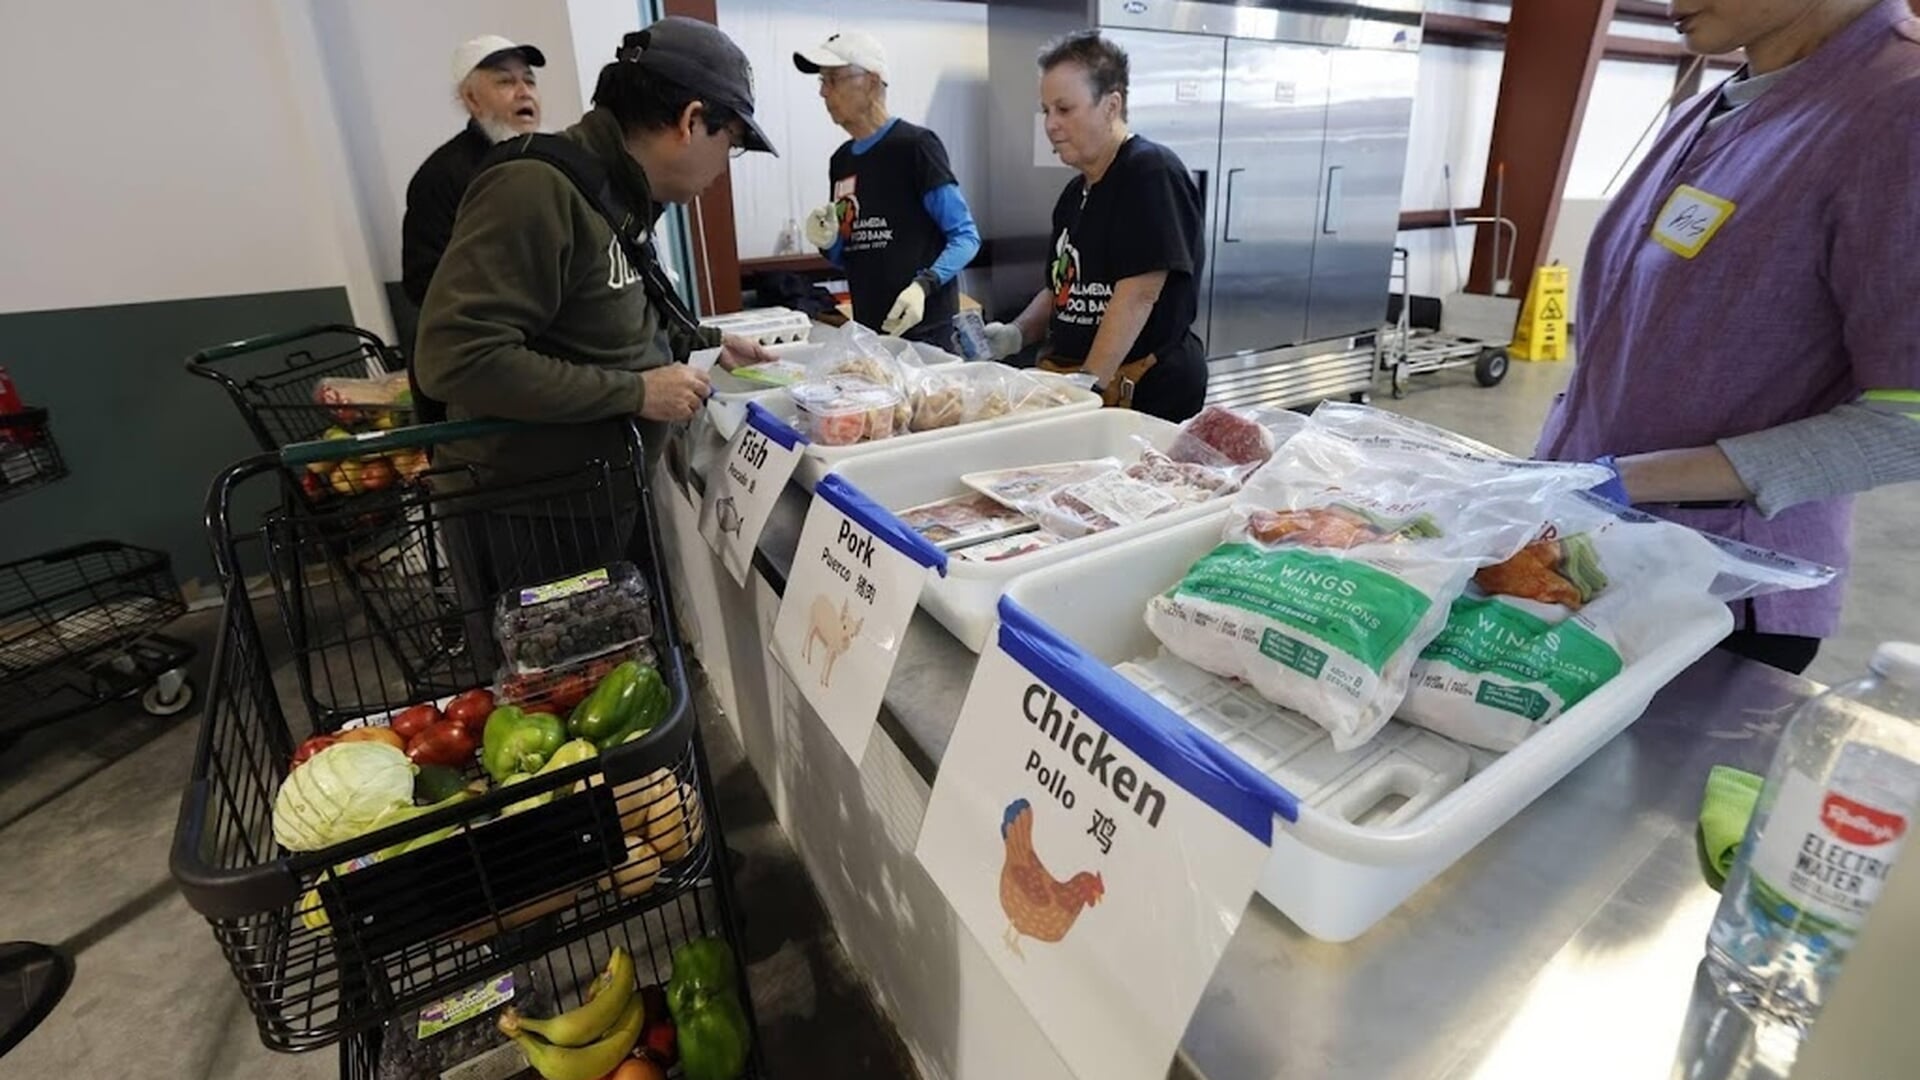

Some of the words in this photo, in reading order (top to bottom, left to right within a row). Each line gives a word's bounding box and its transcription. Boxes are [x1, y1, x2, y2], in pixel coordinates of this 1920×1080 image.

[868, 229, 893, 240] BANK
[738, 429, 769, 469] Fish
[821, 546, 851, 582] Puerco
[837, 518, 876, 568] Pork
[1280, 563, 1357, 598] WINGS
[1280, 579, 1310, 599] WING
[1312, 591, 1382, 630] SECTIONS
[1478, 612, 1562, 652] WINS
[1022, 683, 1167, 829] Chicken
[1025, 750, 1076, 810] Pollo
[1087, 808, 1117, 855] 鸡
[1796, 850, 1864, 894] WATER
